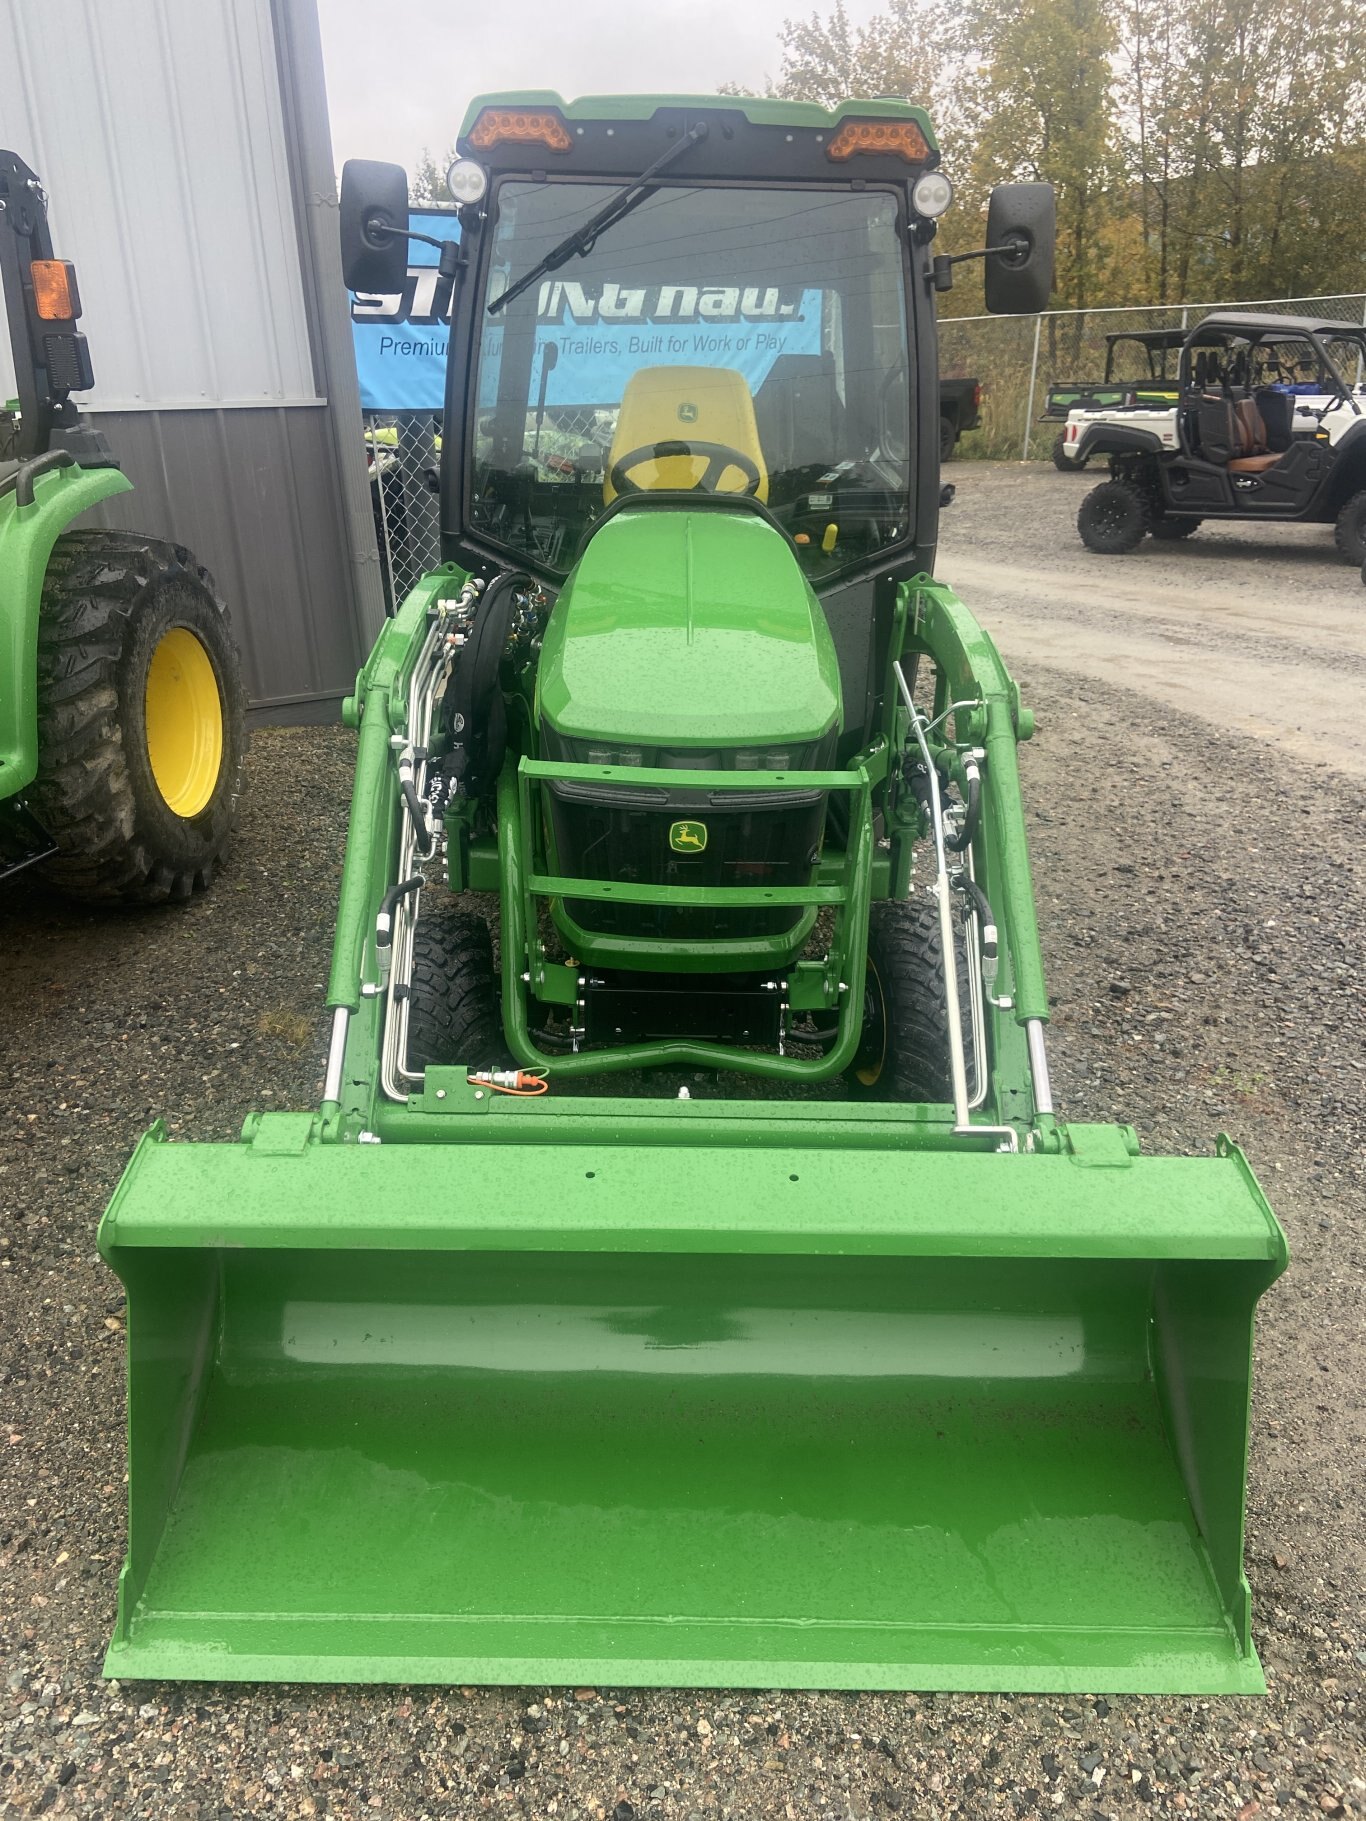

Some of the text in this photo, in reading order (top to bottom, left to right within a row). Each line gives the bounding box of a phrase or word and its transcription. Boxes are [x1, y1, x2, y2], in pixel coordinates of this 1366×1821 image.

[380, 336, 449, 356] Premiu
[559, 336, 623, 357] Trailers,
[628, 335, 664, 354] Built
[667, 335, 689, 352] for
[694, 334, 732, 352] Work
[736, 338, 752, 351] or
[755, 333, 788, 354] Play
